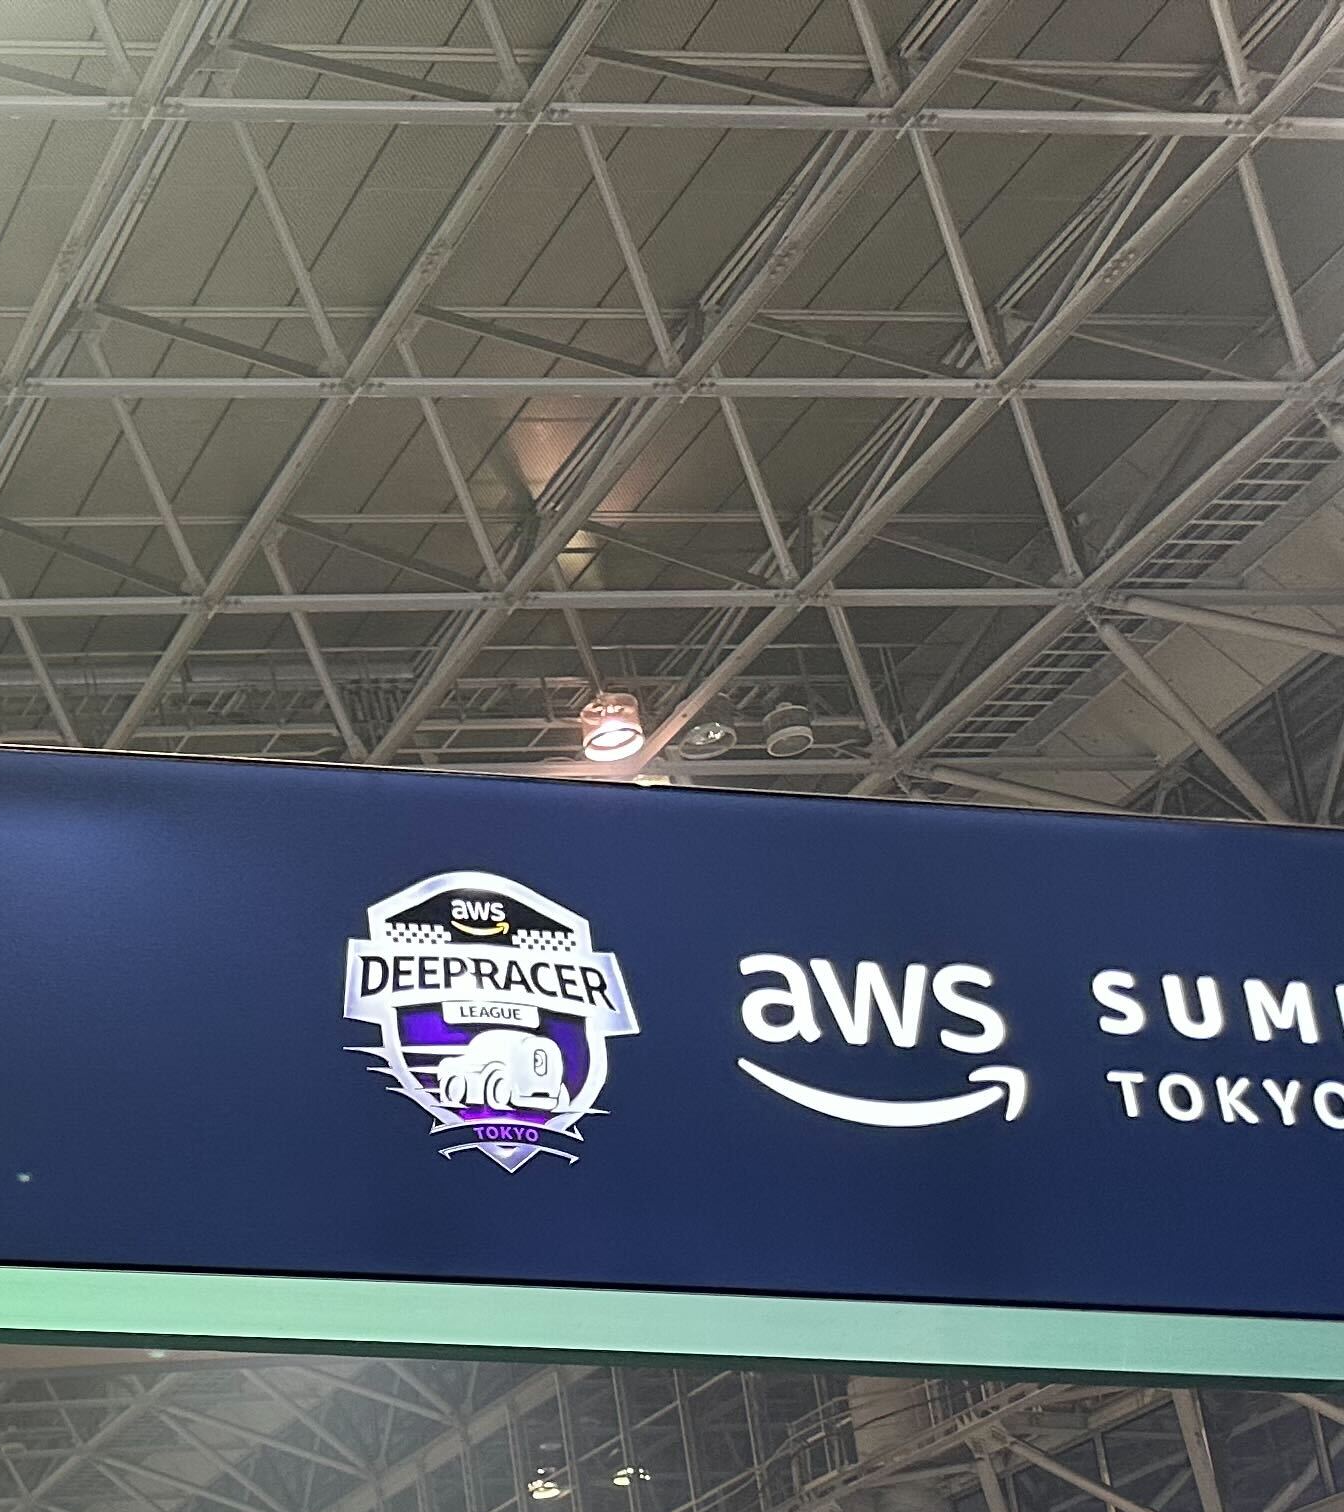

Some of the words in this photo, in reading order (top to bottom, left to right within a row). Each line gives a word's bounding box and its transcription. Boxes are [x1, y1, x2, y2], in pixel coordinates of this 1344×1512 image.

[450, 899, 507, 922] aws
[359, 954, 616, 1012] DEEPRACER
[459, 1004, 523, 1021] LEAGUE
[739, 951, 1007, 1054] aws
[1091, 968, 1344, 1044] SUM
[472, 1125, 540, 1143] TOKYO
